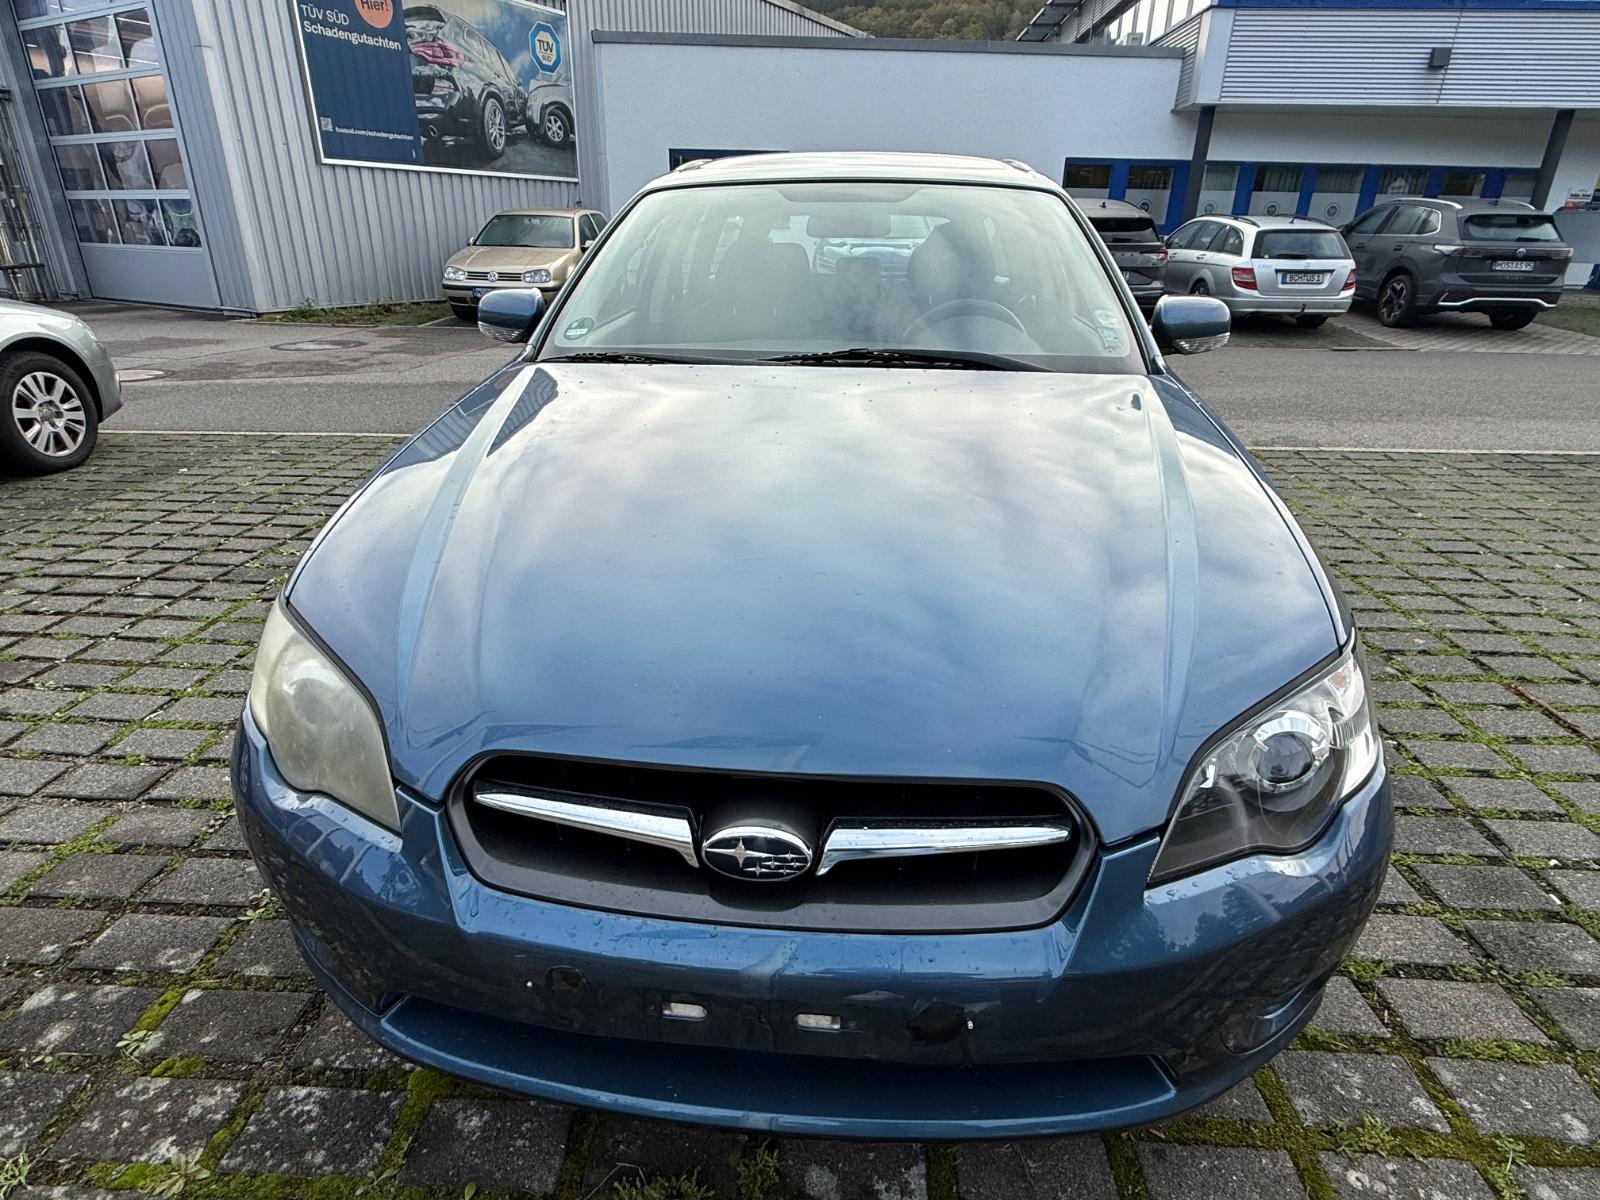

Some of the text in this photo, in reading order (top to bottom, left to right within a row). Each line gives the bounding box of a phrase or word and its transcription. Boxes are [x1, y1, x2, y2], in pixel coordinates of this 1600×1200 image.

[300, 4, 350, 26] TÜV SÜD
[360, 0, 389, 11] Hier!
[303, 20, 402, 51] Schadengutachten
